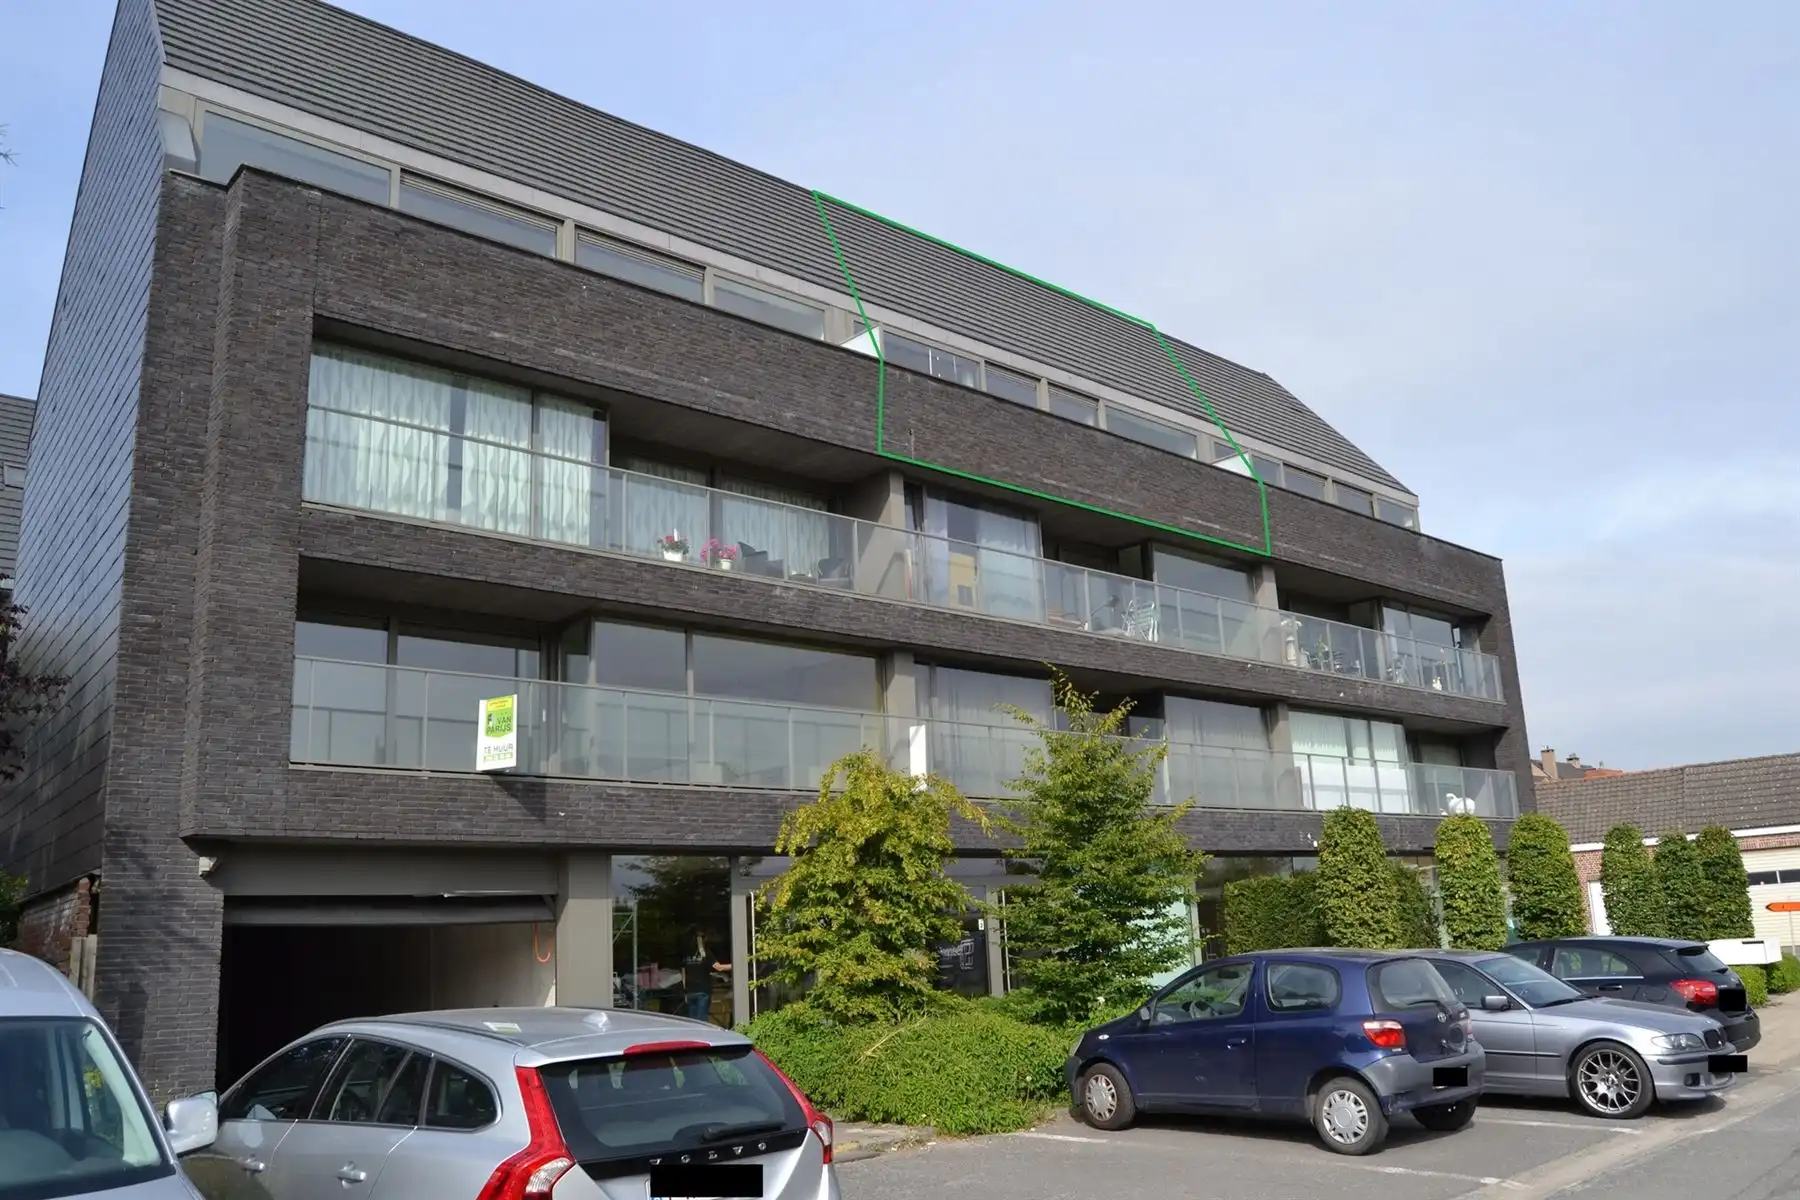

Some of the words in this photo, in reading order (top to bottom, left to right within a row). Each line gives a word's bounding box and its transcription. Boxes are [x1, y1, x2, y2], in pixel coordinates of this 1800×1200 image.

[497, 716, 512, 725] VAN
[493, 743, 513, 753] HUUR
[649, 1142, 767, 1165] VOLVO
